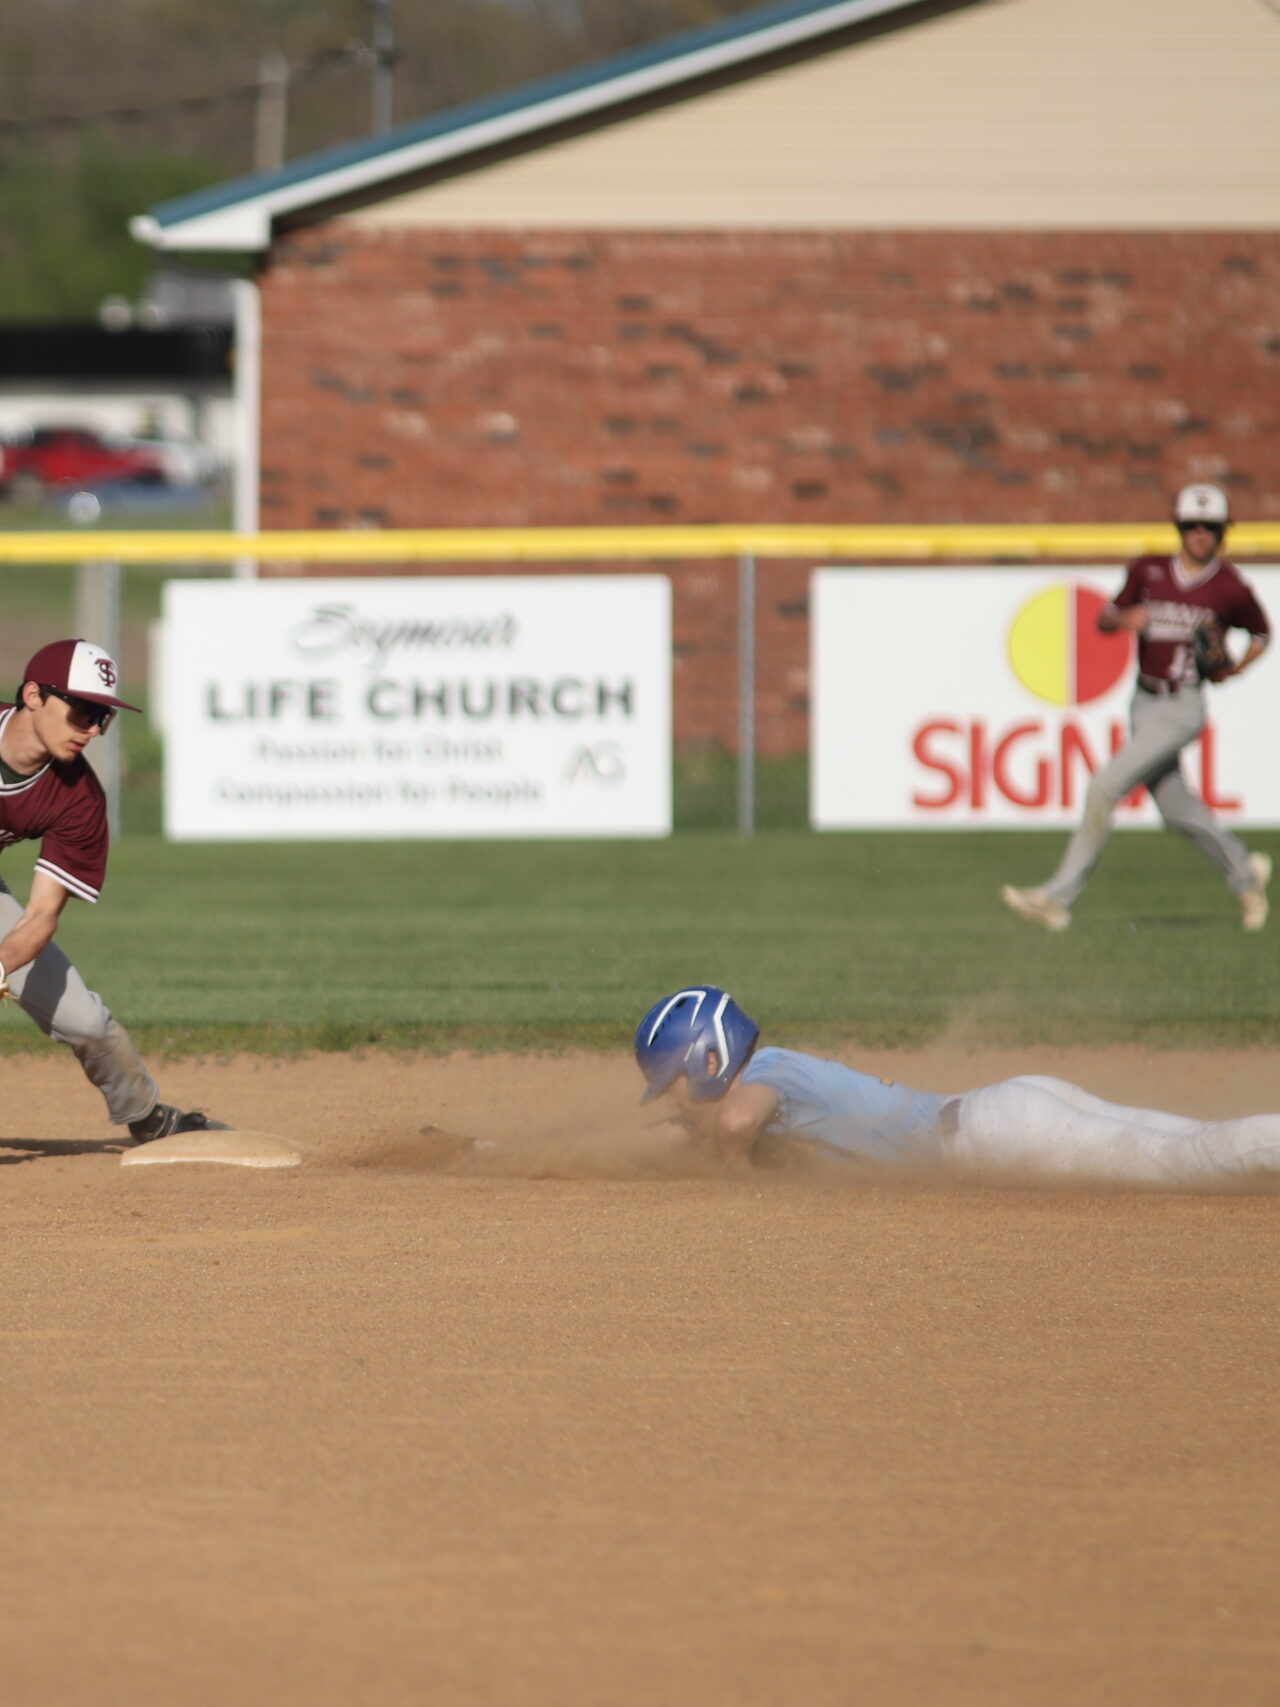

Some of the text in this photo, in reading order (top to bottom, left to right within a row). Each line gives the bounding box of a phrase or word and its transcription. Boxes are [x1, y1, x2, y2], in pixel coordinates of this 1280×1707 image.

[293, 603, 517, 668] Seymour
[206, 678, 635, 721] LIFE CHURCH
[911, 721, 1242, 809] SIGNL
